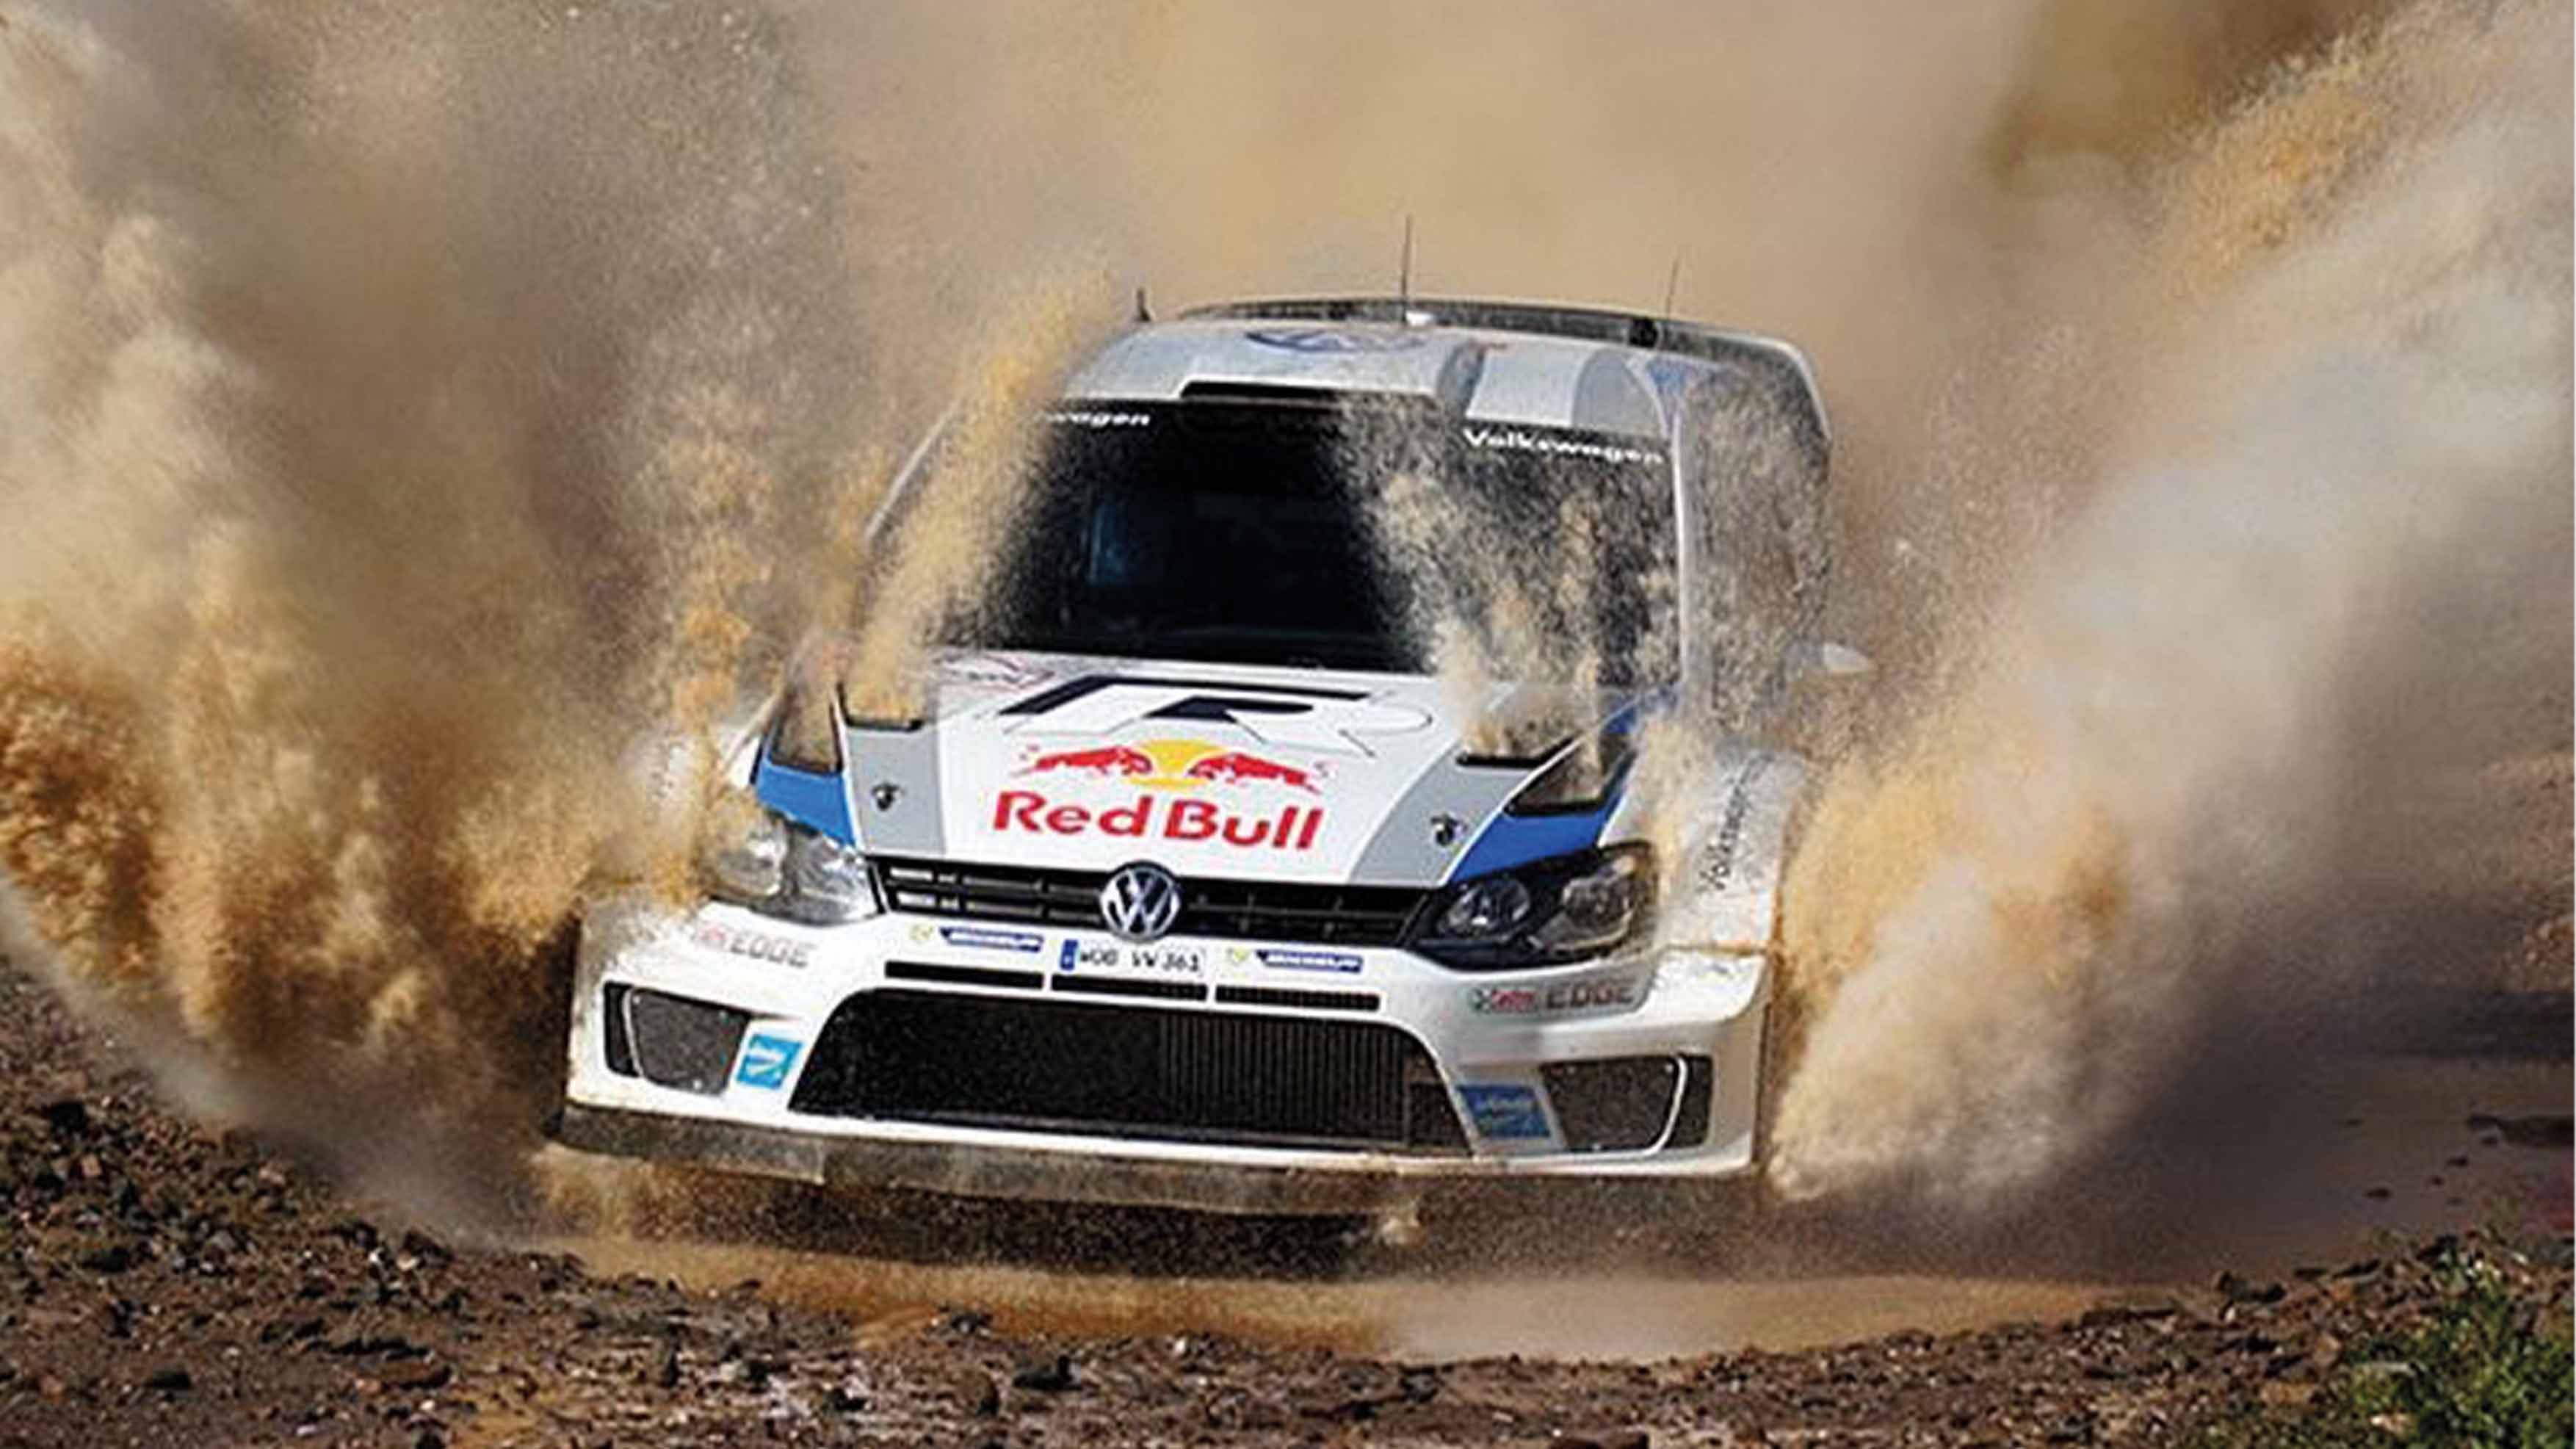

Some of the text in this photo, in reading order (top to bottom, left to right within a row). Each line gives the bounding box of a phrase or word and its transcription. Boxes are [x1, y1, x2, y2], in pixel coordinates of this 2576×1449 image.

[1046, 412, 1151, 428] wagen
[1463, 428, 1663, 464] Volkswagen
[994, 791, 1323, 850] Red Bull
[730, 931, 818, 969] EDGE
[1545, 980, 1638, 1010] EDGE
